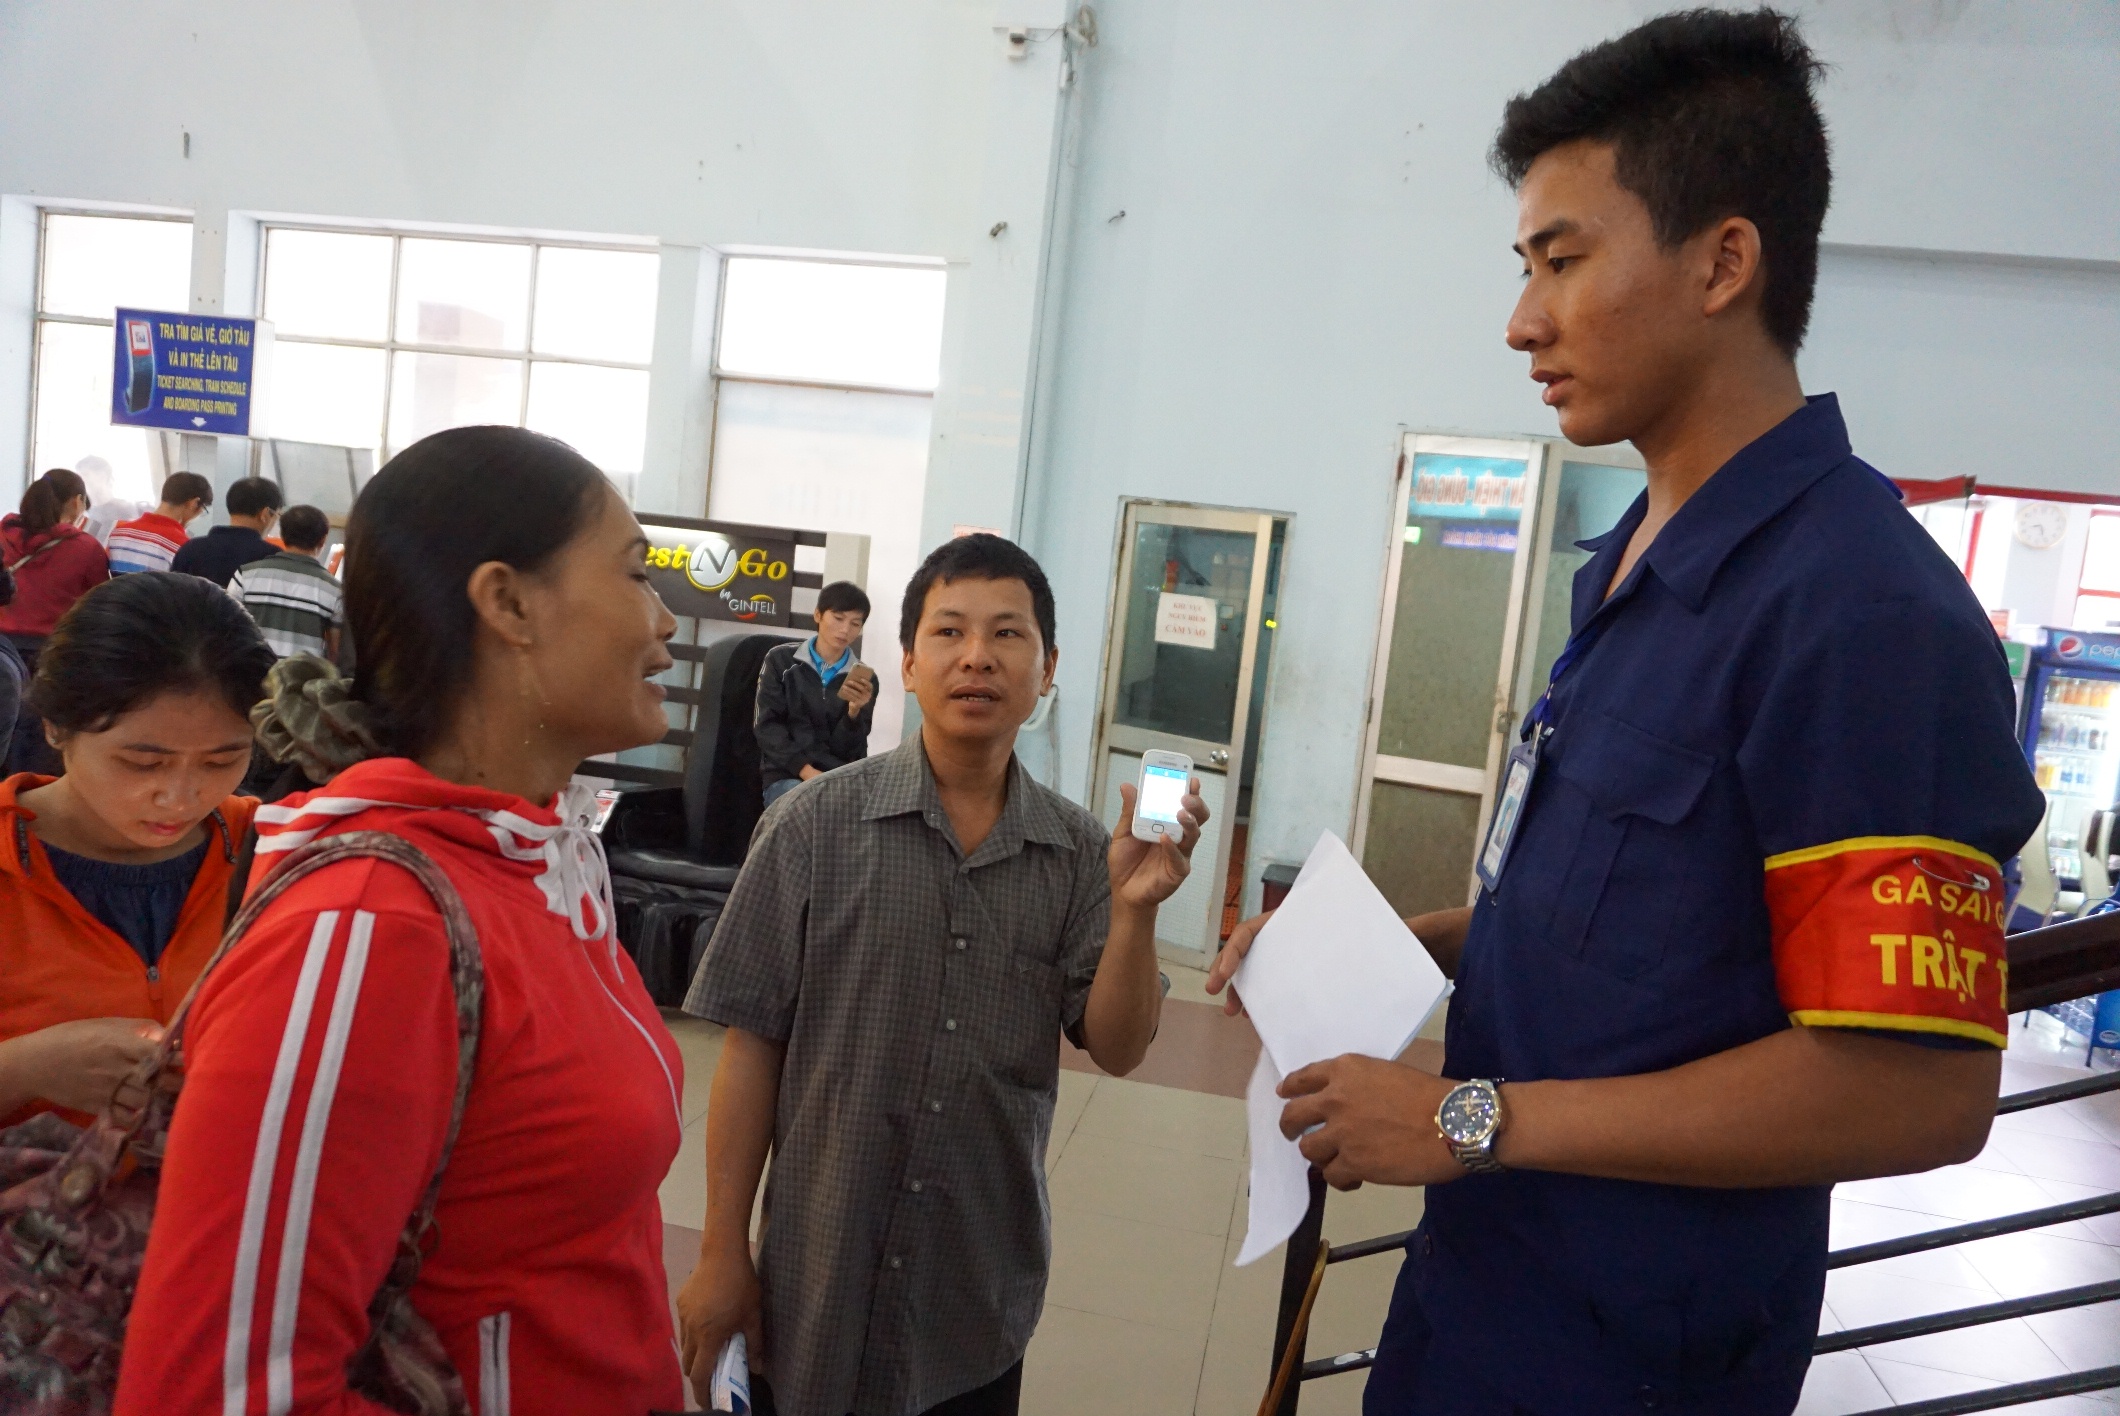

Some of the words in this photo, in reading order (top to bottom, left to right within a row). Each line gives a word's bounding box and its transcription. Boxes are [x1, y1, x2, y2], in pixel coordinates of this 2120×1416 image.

[159, 323, 174, 338] TRA
[176, 321, 189, 340] TÌM
[190, 322, 203, 342] GIÁ
[219, 325, 233, 345] GIỜ
[234, 326, 249, 346] TÀU
[168, 347, 179, 366] VÀ
[180, 351, 188, 367] IN
[206, 350, 221, 371] LÊN
[223, 351, 238, 371] TÀU
[157, 375, 175, 389] TICKET
[205, 379, 220, 394] TRAIN
[220, 380, 246, 396] SCHEDULE
[164, 396, 174, 409] AND
[174, 397, 200, 412] BOARDING
[201, 400, 214, 413] PASS
[214, 401, 237, 415] PRINTING
[737, 548, 788, 581] Go
[719, 588, 732, 601] by
[729, 599, 777, 615] GINTELL
[1872, 874, 1933, 906] GA
[1870, 929, 1987, 1003] TRẬT
